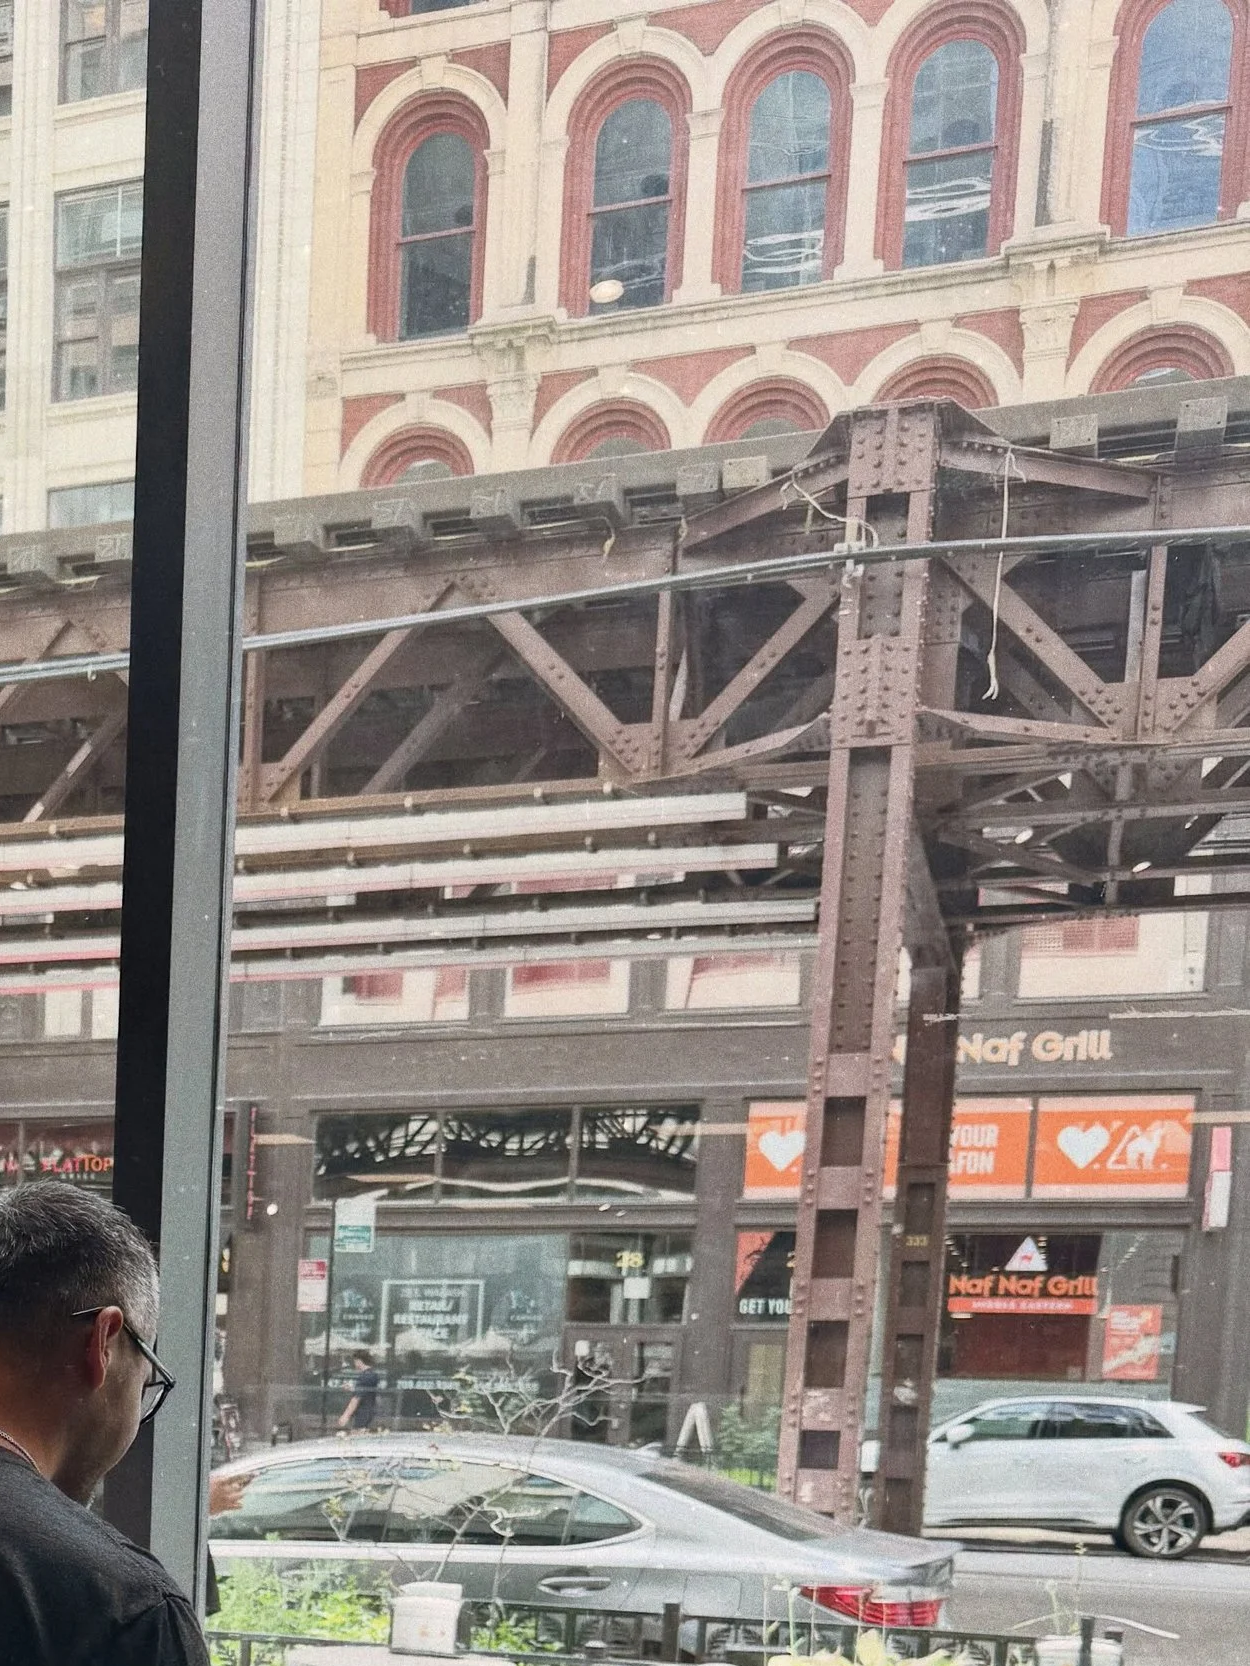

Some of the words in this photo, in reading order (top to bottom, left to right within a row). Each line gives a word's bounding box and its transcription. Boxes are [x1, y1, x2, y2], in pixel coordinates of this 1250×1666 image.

[956, 1030, 1027, 1066] Naf
[1031, 1028, 1114, 1063] Grill
[949, 1274, 996, 1297] Naf
[999, 1274, 1045, 1297] Naf
[1047, 1274, 1098, 1297] Grill
[738, 1299, 765, 1315] GET
[768, 1299, 794, 1315] YOU
